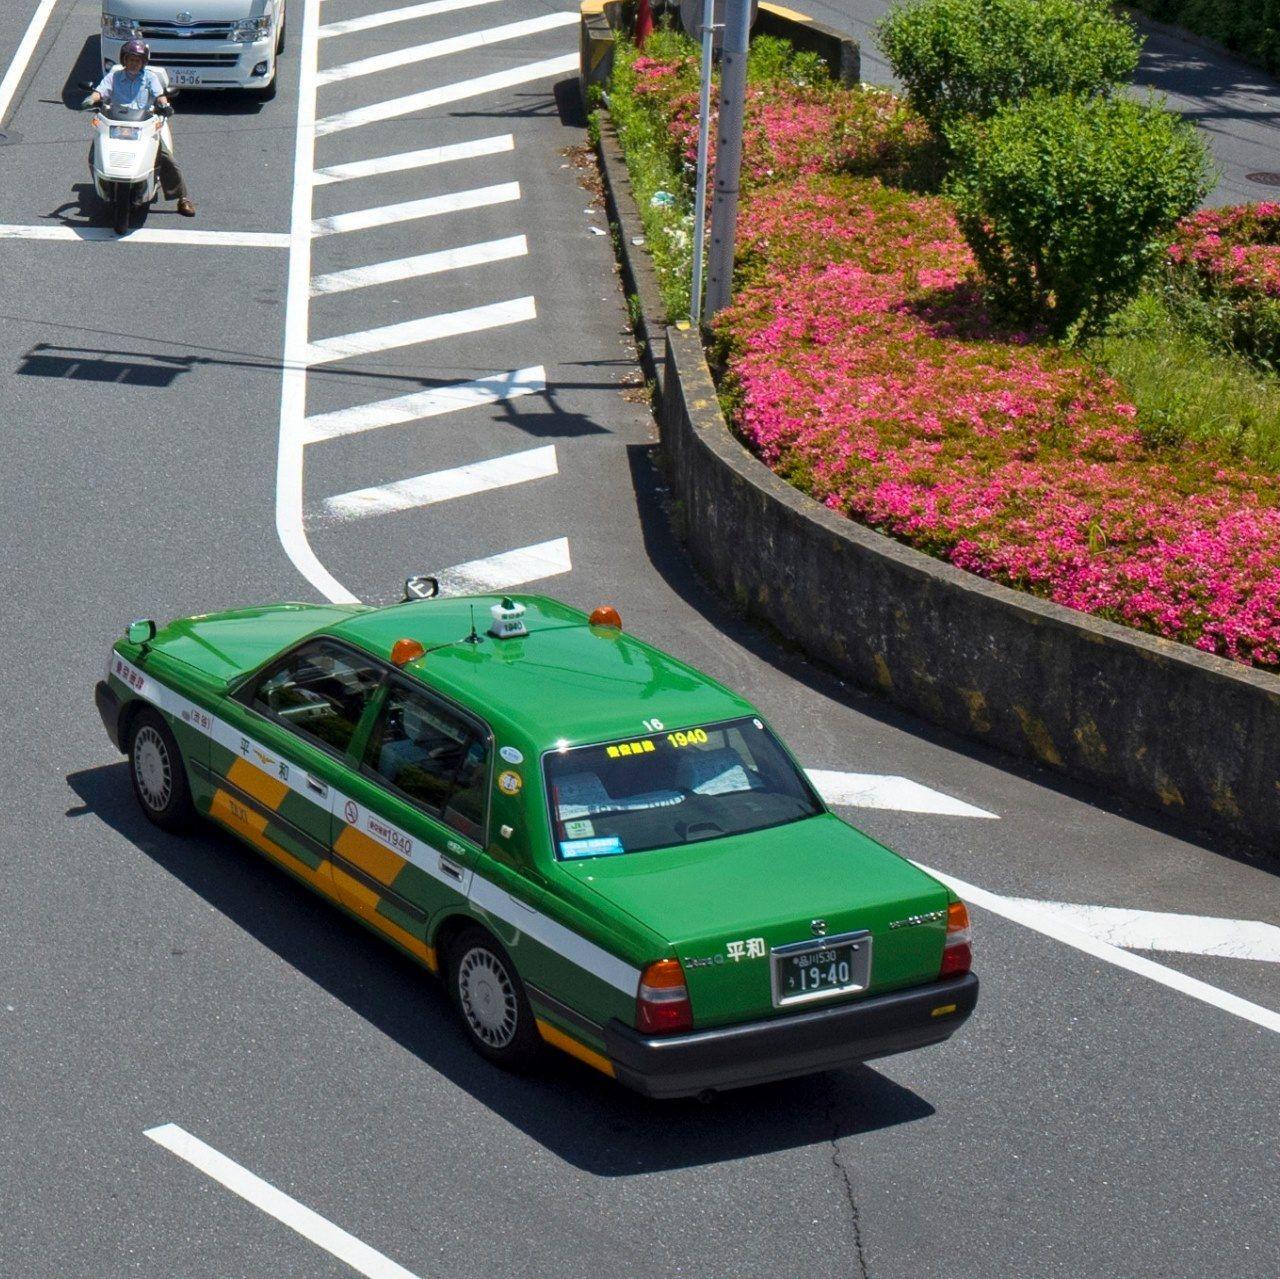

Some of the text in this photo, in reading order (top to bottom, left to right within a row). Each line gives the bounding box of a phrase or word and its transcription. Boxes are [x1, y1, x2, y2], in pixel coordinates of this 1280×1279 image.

[504, 621, 523, 632] 1940
[667, 728, 708, 748] 1940
[726, 937, 766, 963] 平和
[800, 961, 850, 990] 19-40
